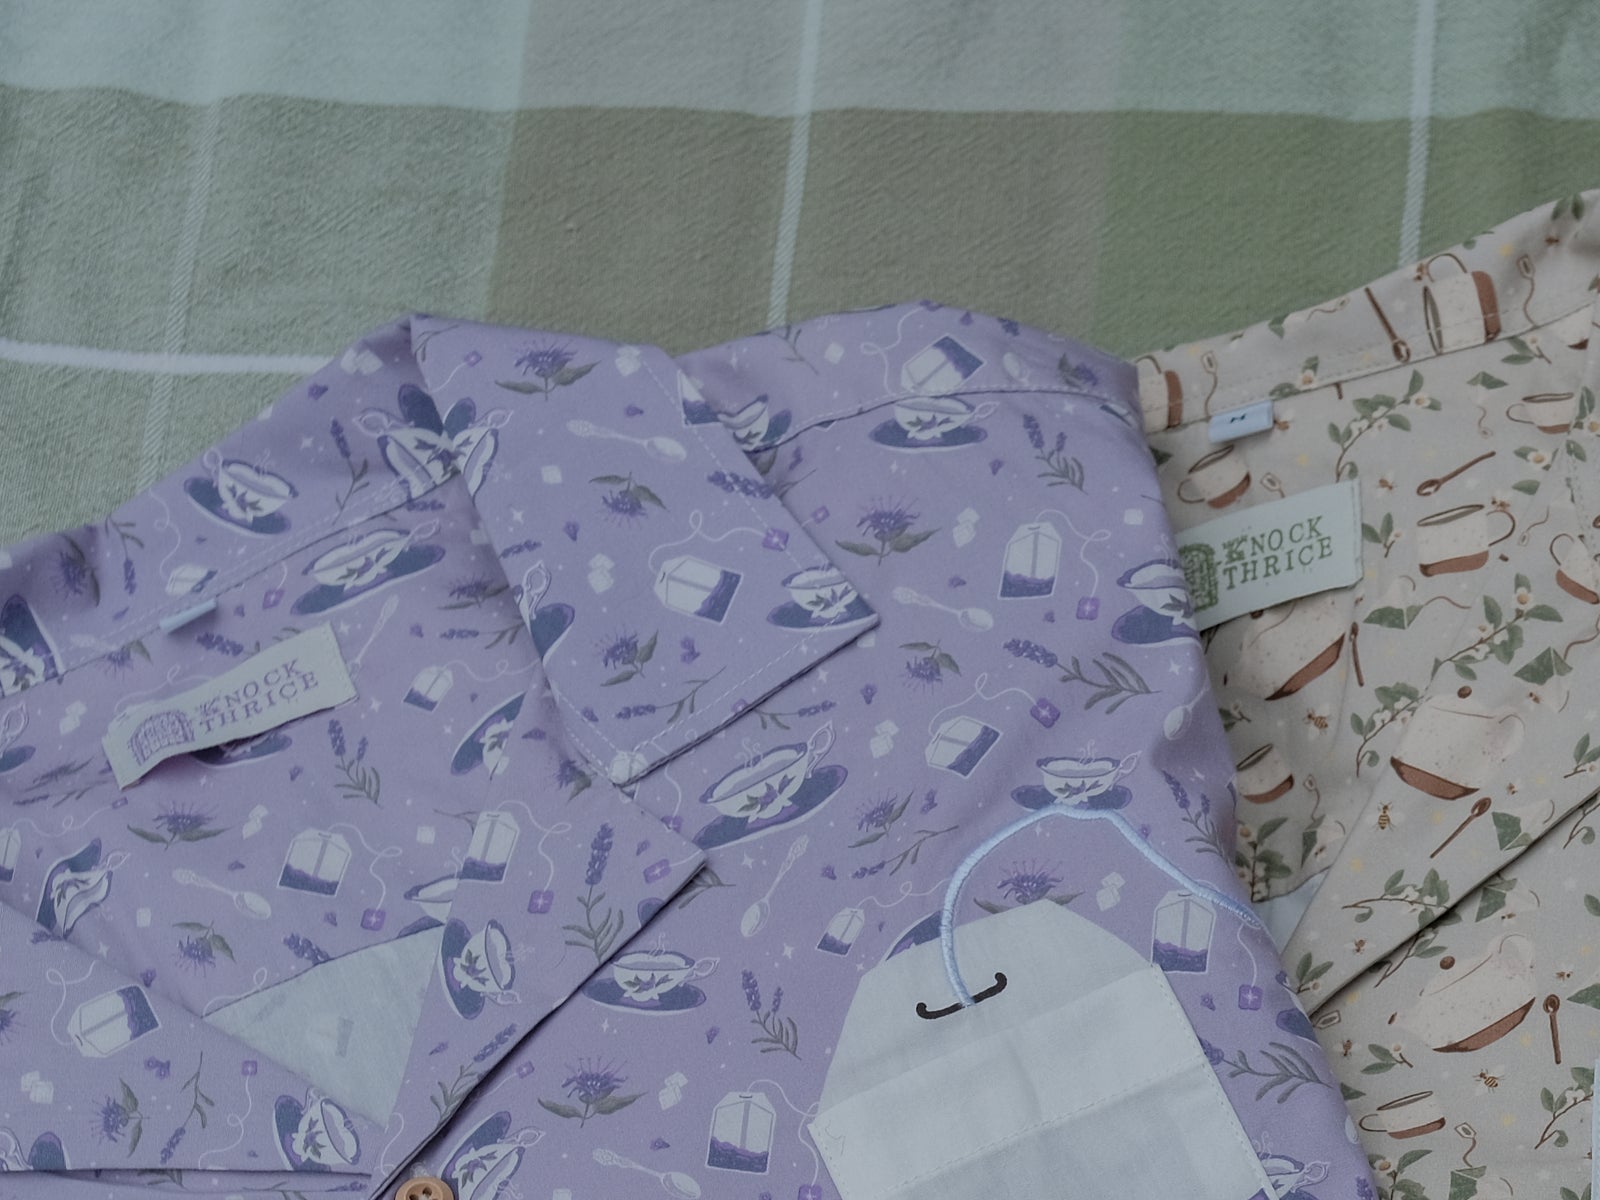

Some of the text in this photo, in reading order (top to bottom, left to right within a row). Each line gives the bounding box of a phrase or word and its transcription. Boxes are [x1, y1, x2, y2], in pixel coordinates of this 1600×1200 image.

[1222, 516, 1323, 565] KNOCK
[1223, 536, 1333, 590] THRICE
[198, 659, 303, 717] KNOCK
[200, 671, 319, 734] THRICE
